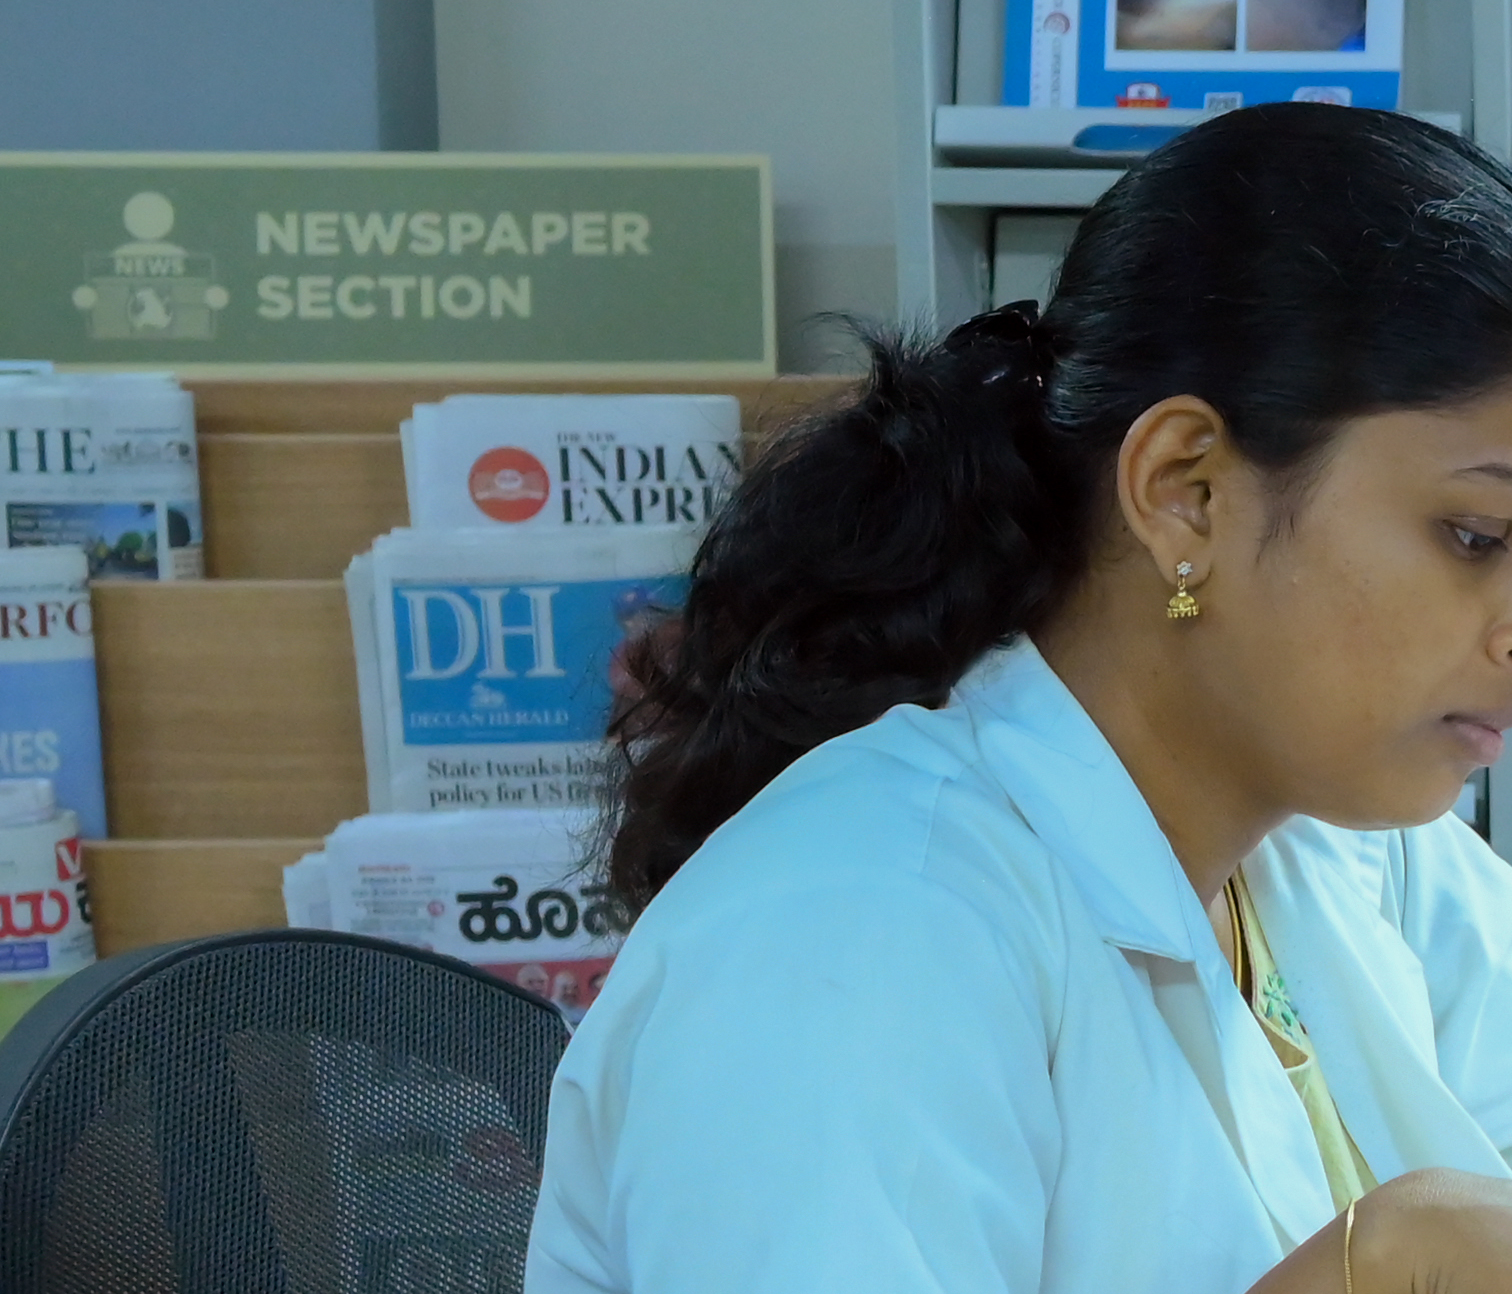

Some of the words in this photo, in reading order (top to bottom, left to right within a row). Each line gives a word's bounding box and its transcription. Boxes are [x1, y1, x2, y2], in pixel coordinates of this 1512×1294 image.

[256, 212, 652, 256] NEWSPAPER
[115, 257, 186, 276] NEWS
[257, 276, 533, 320] SECTION
[403, 586, 566, 681] DH
[410, 712, 485, 729] DECCAN
[489, 710, 570, 726] HERALD
[427, 759, 483, 780] State
[486, 758, 561, 779] tweaks
[430, 784, 490, 808] policy
[496, 782, 525, 803] for
[531, 783, 562, 803] US
